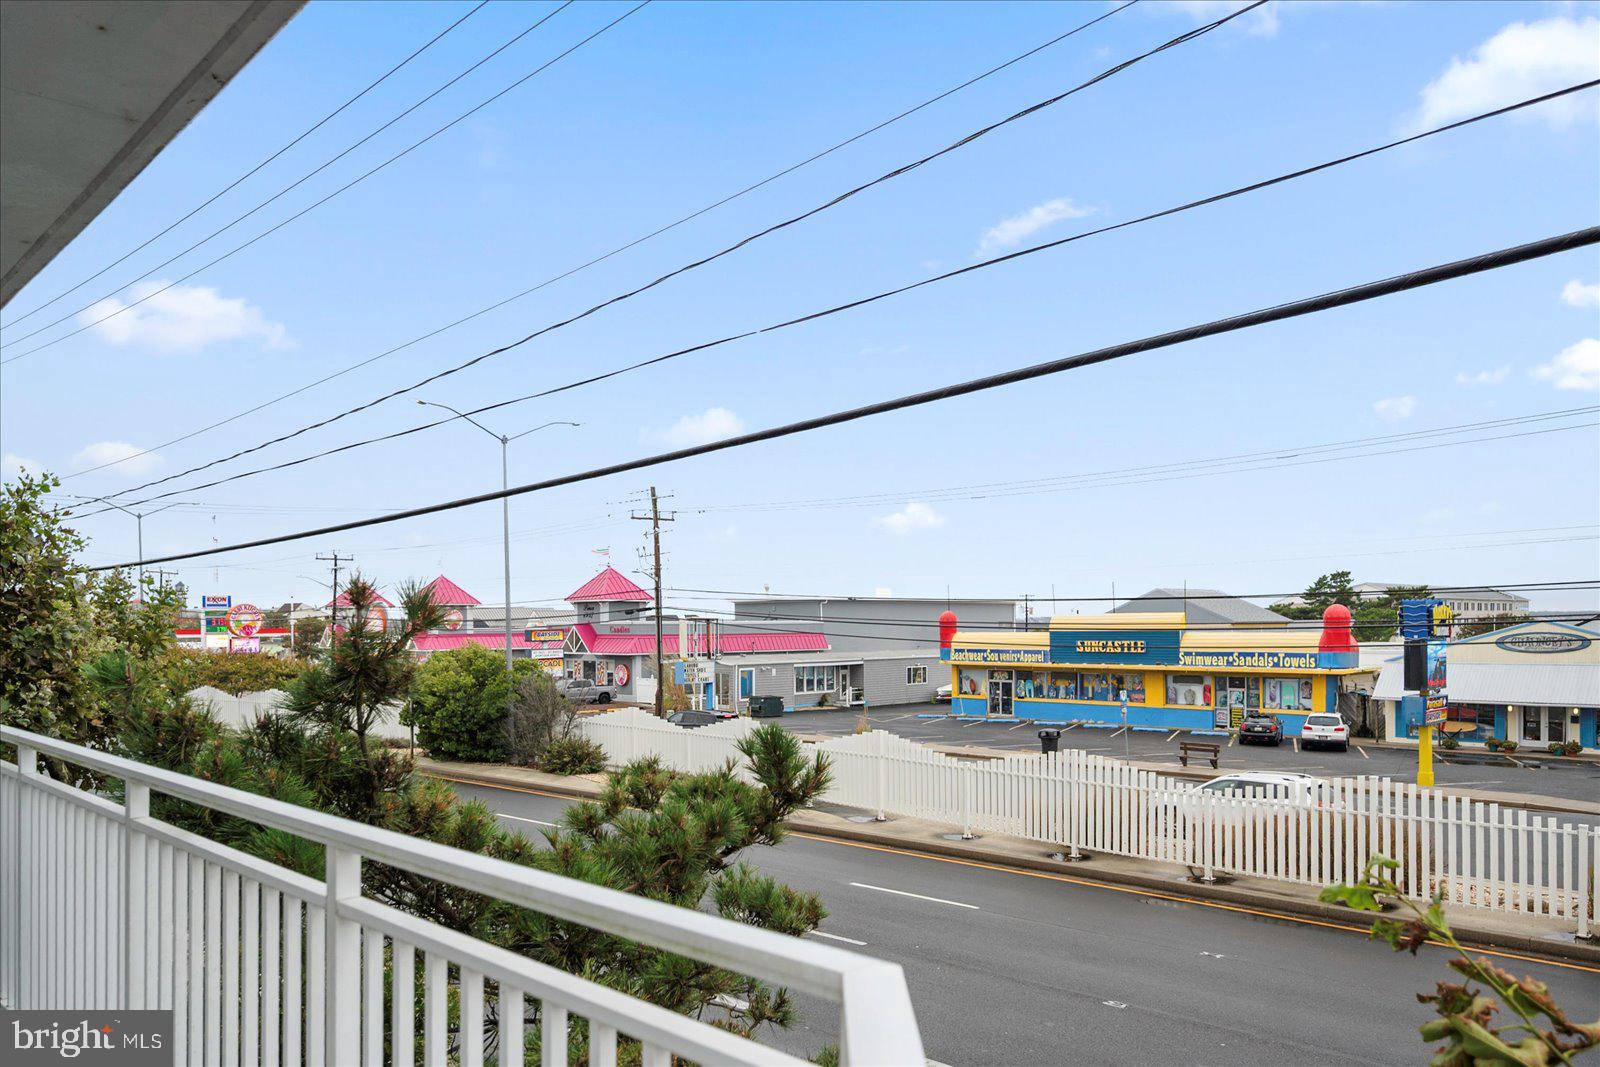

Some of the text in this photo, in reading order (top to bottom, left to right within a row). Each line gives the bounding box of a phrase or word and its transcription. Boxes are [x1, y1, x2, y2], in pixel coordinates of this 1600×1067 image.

[1076, 640, 1146, 653] SUNCASTLE
[951, 649, 984, 661] Beachwear
[1020, 651, 1044, 663] Apparel
[1179, 652, 1316, 668] Swimwear Sandals Towels
